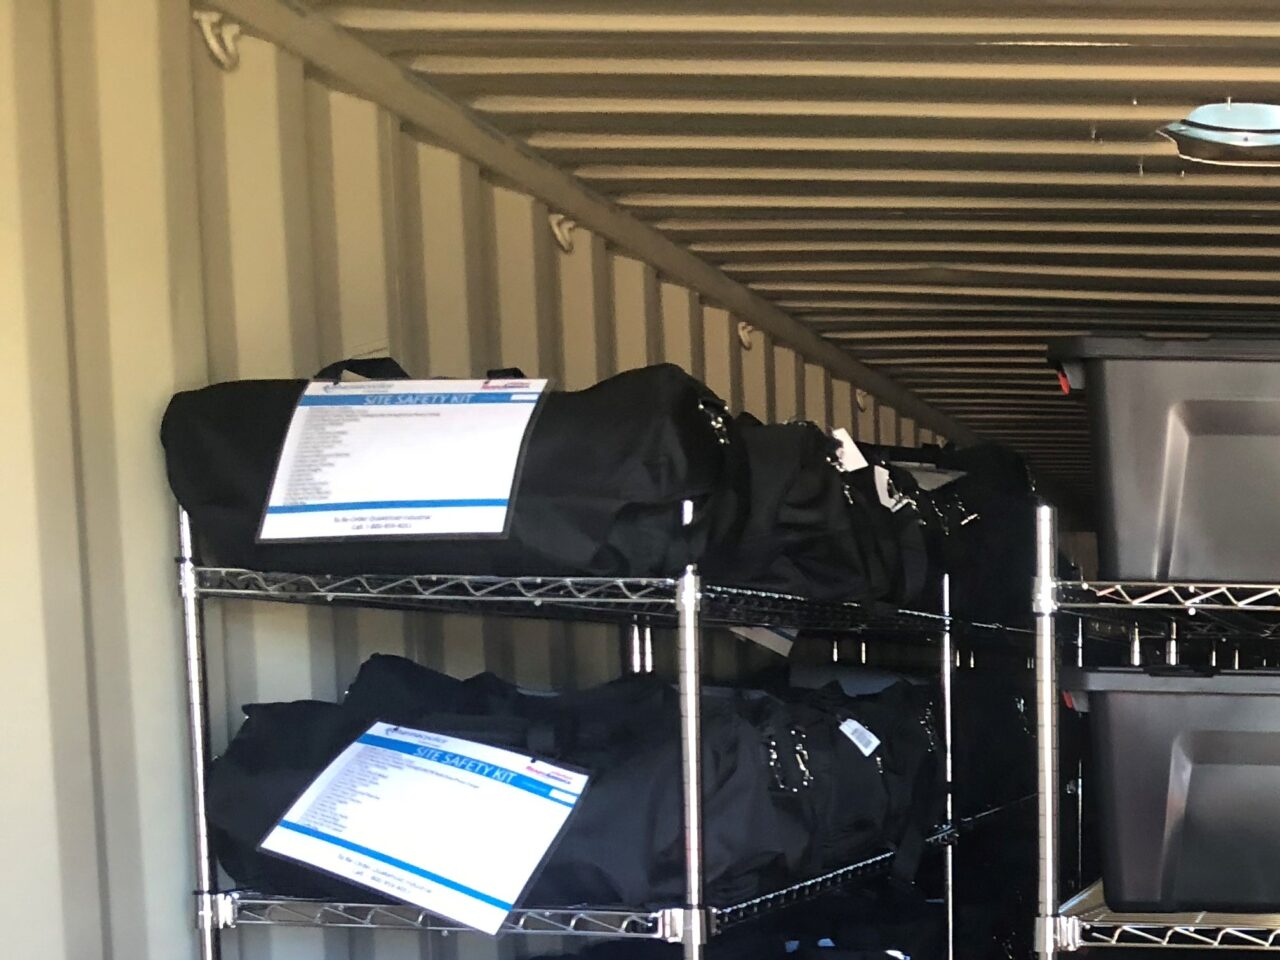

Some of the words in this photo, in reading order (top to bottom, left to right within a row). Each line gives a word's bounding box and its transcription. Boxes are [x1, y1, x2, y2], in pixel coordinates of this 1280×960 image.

[363, 394, 393, 406] SITE
[396, 393, 448, 406] SAFETY
[451, 393, 474, 405] KIT
[412, 745, 440, 762] SITE
[443, 752, 492, 777] SAFETY
[494, 765, 517, 785] KIT
